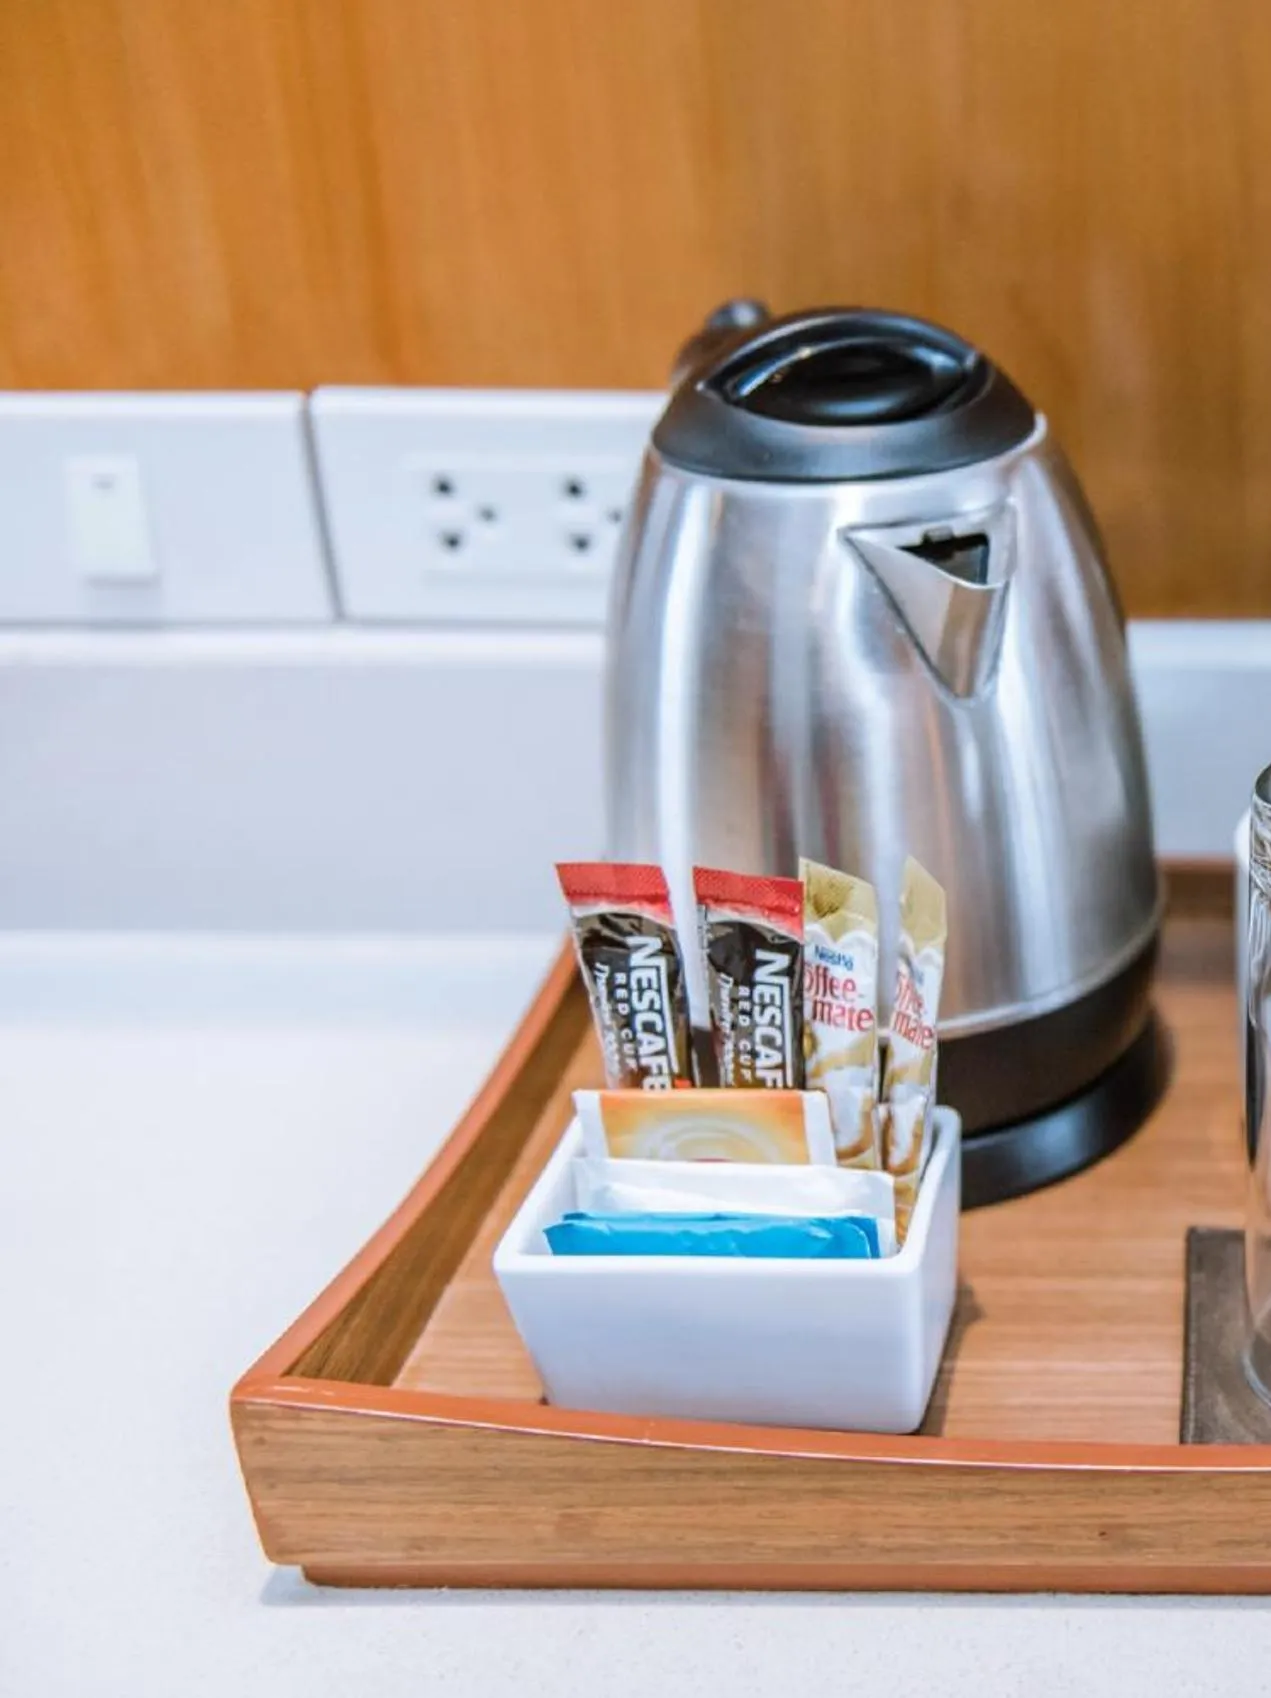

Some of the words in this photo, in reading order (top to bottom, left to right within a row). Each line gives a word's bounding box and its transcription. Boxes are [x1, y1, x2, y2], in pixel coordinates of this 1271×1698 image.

[614, 972, 630, 1015] RED
[803, 961, 867, 1001] offee-
[738, 985, 751, 1027] RED
[753, 949, 794, 1089] NESCAF
[812, 1000, 874, 1032] mate
[620, 1027, 638, 1072] CUP
[738, 1038, 752, 1084] CUP
